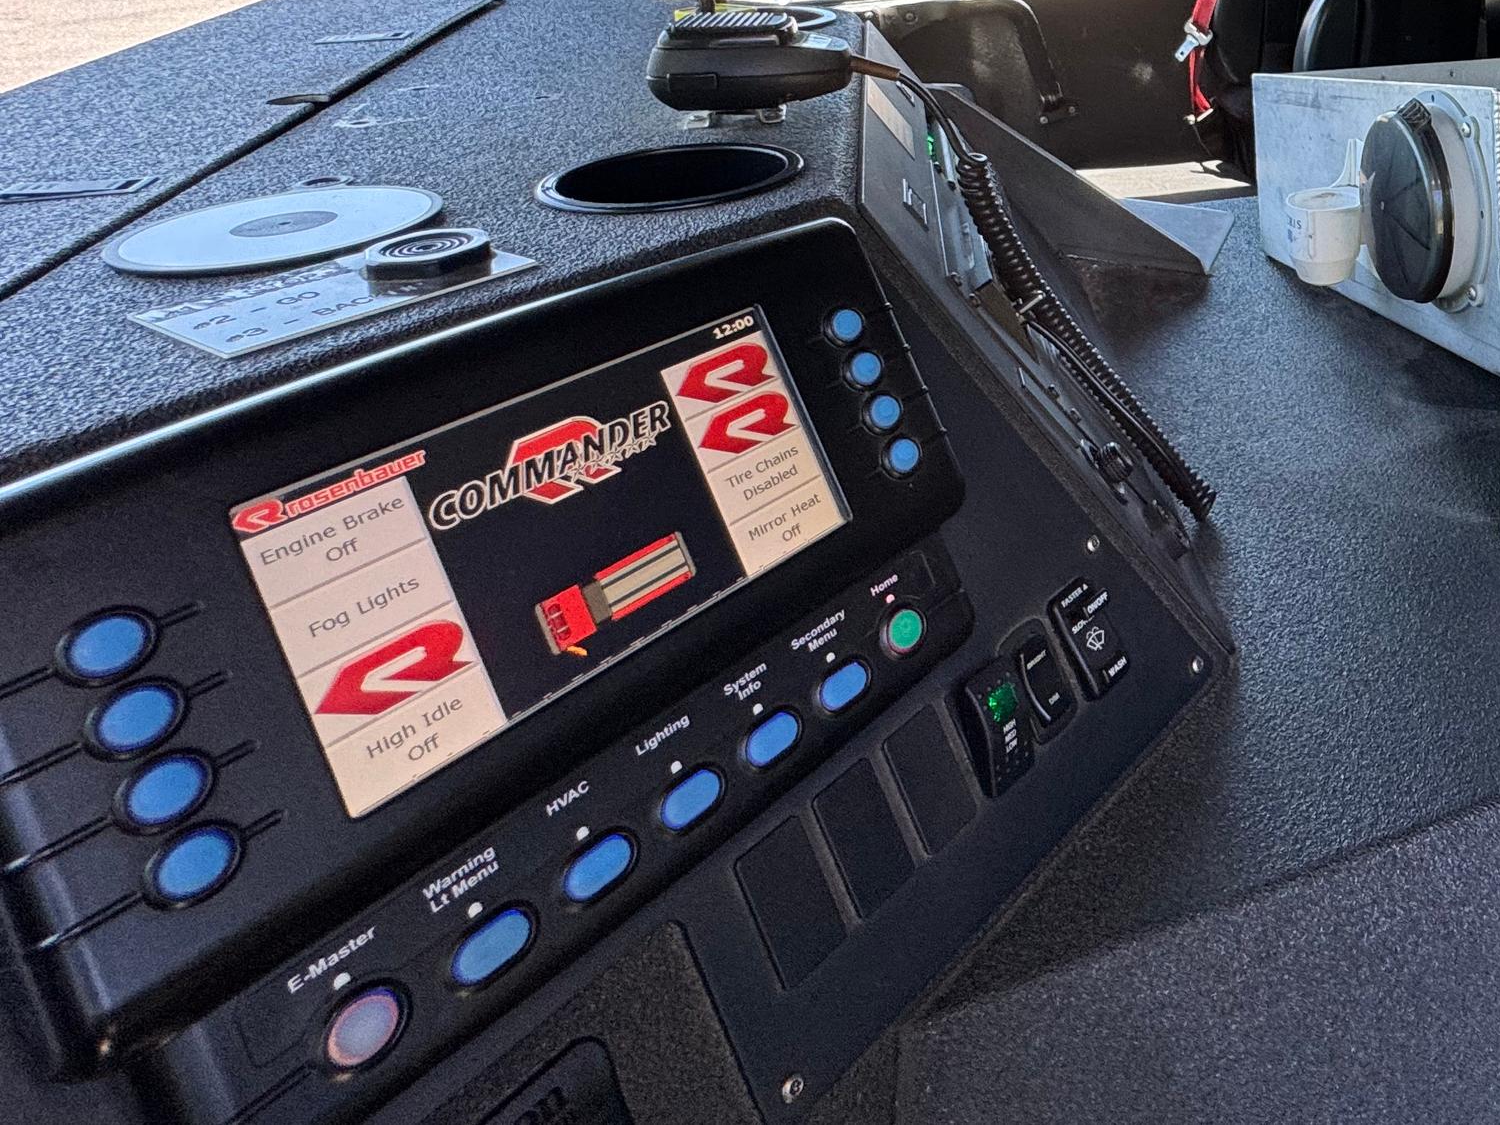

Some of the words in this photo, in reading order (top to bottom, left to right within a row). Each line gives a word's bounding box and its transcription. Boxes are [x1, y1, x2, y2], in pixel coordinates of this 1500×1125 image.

[276, 291, 320, 306] GO
[712, 315, 754, 340] 12:00
[428, 400, 672, 530] COMMANDER
[724, 469, 753, 489] Tire
[756, 445, 800, 474] Chains
[743, 464, 800, 501] Disabled
[260, 527, 337, 565] Engine
[342, 497, 405, 531] Brake
[748, 510, 789, 541] Mirror
[791, 493, 822, 518] Heat
[782, 523, 802, 543] Off
[325, 537, 359, 562] Off
[869, 573, 899, 597] Home
[308, 610, 350, 637] Fog
[356, 577, 420, 615] Lights
[790, 608, 847, 651] Secondary
[807, 627, 838, 653] Menu
[723, 662, 768, 697] System
[1107, 656, 1128, 677] WASH
[738, 679, 762, 701] Info
[366, 723, 417, 759] High
[422, 697, 463, 727] Idle
[407, 732, 441, 761] Off
[635, 714, 691, 756] Lighting
[545, 780, 591, 817] HVAC
[422, 846, 497, 899] Warning
[429, 893, 450, 913] Lt
[451, 860, 500, 898] Menu
[287, 926, 376, 994] E-Master
